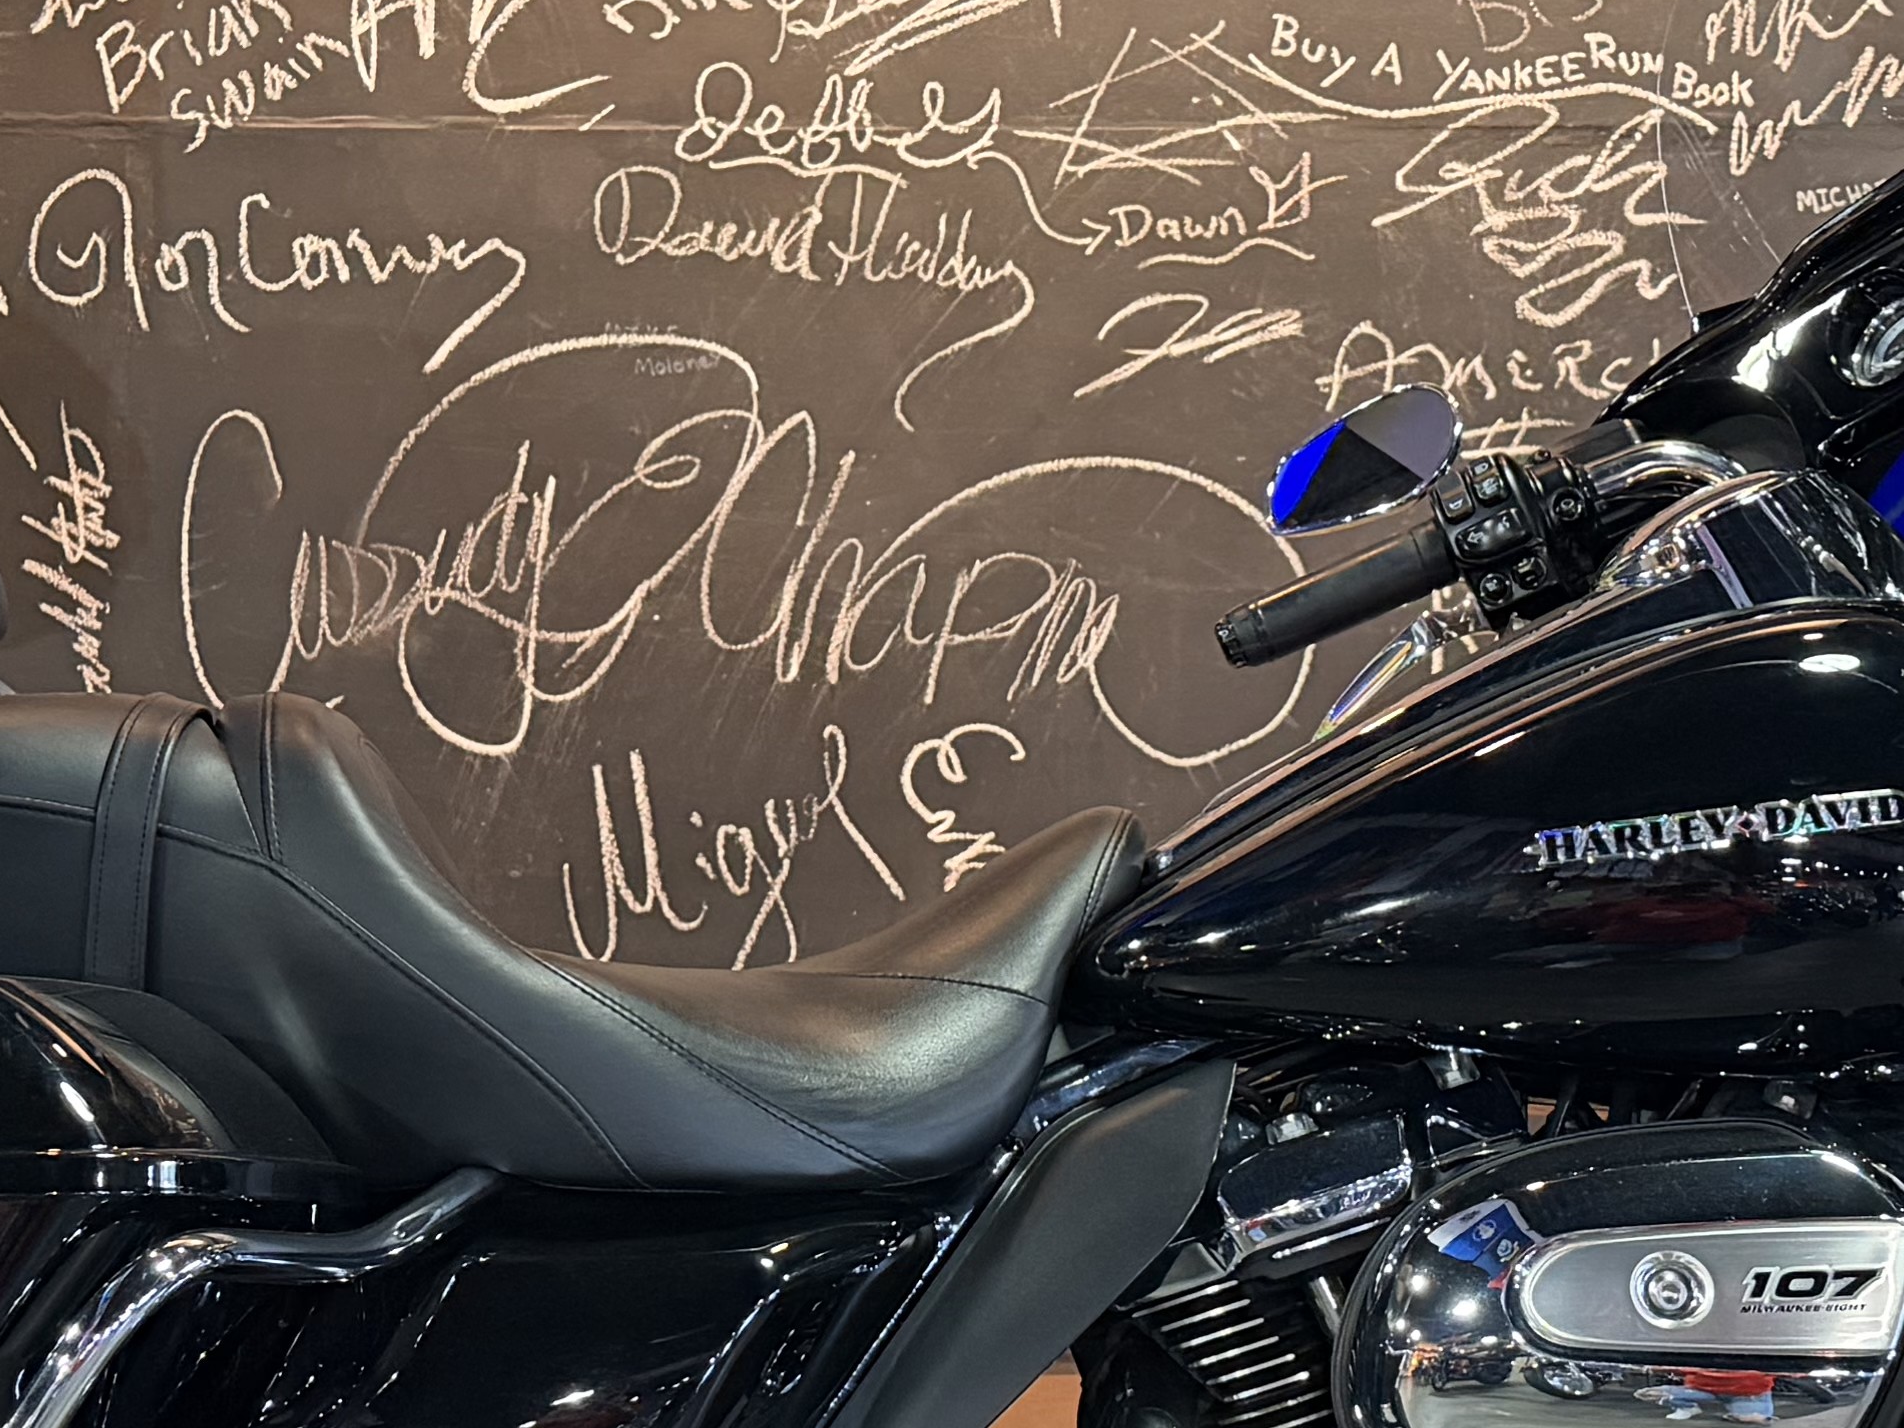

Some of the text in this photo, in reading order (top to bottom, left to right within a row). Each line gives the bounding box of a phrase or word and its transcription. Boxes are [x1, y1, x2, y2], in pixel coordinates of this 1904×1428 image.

[1371, 42, 1404, 85] A
[1433, 49, 1589, 101] YANKEE
[1582, 31, 1666, 77] RUN
[1107, 202, 1249, 250] Dawn
[1744, 1267, 1884, 1302] 107
[1740, 1303, 1867, 1314] MILWAUKEE-EIGHT
